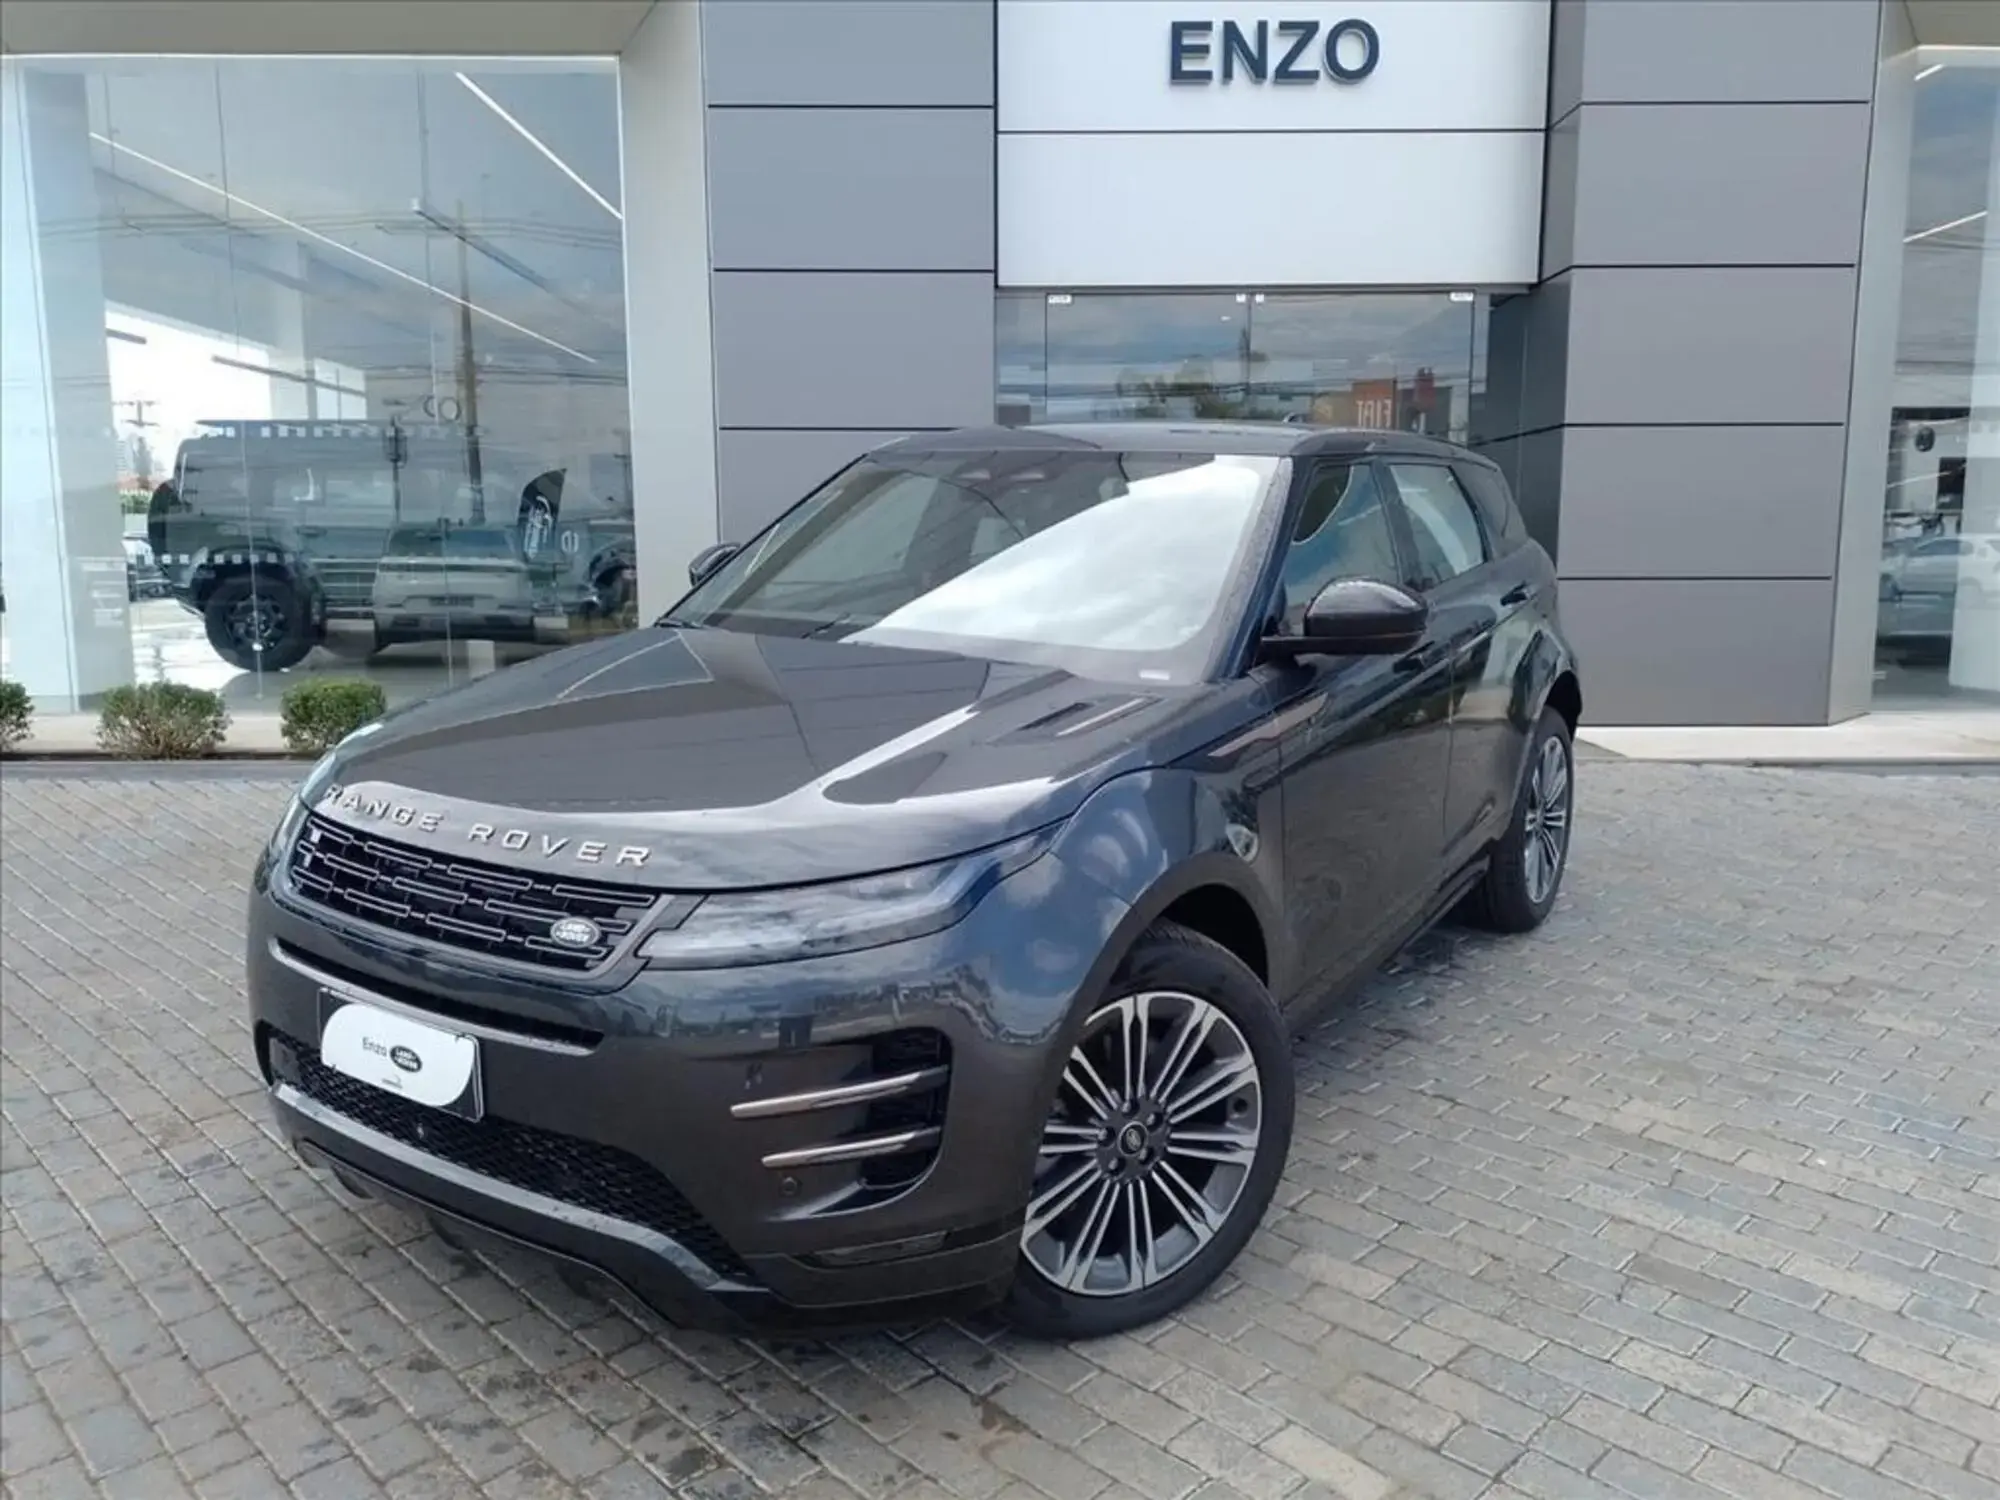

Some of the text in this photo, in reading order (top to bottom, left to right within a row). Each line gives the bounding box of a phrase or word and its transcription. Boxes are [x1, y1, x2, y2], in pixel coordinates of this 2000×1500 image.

[1170, 19, 1380, 84] ENZO
[324, 784, 654, 868] RANGE ROVER
